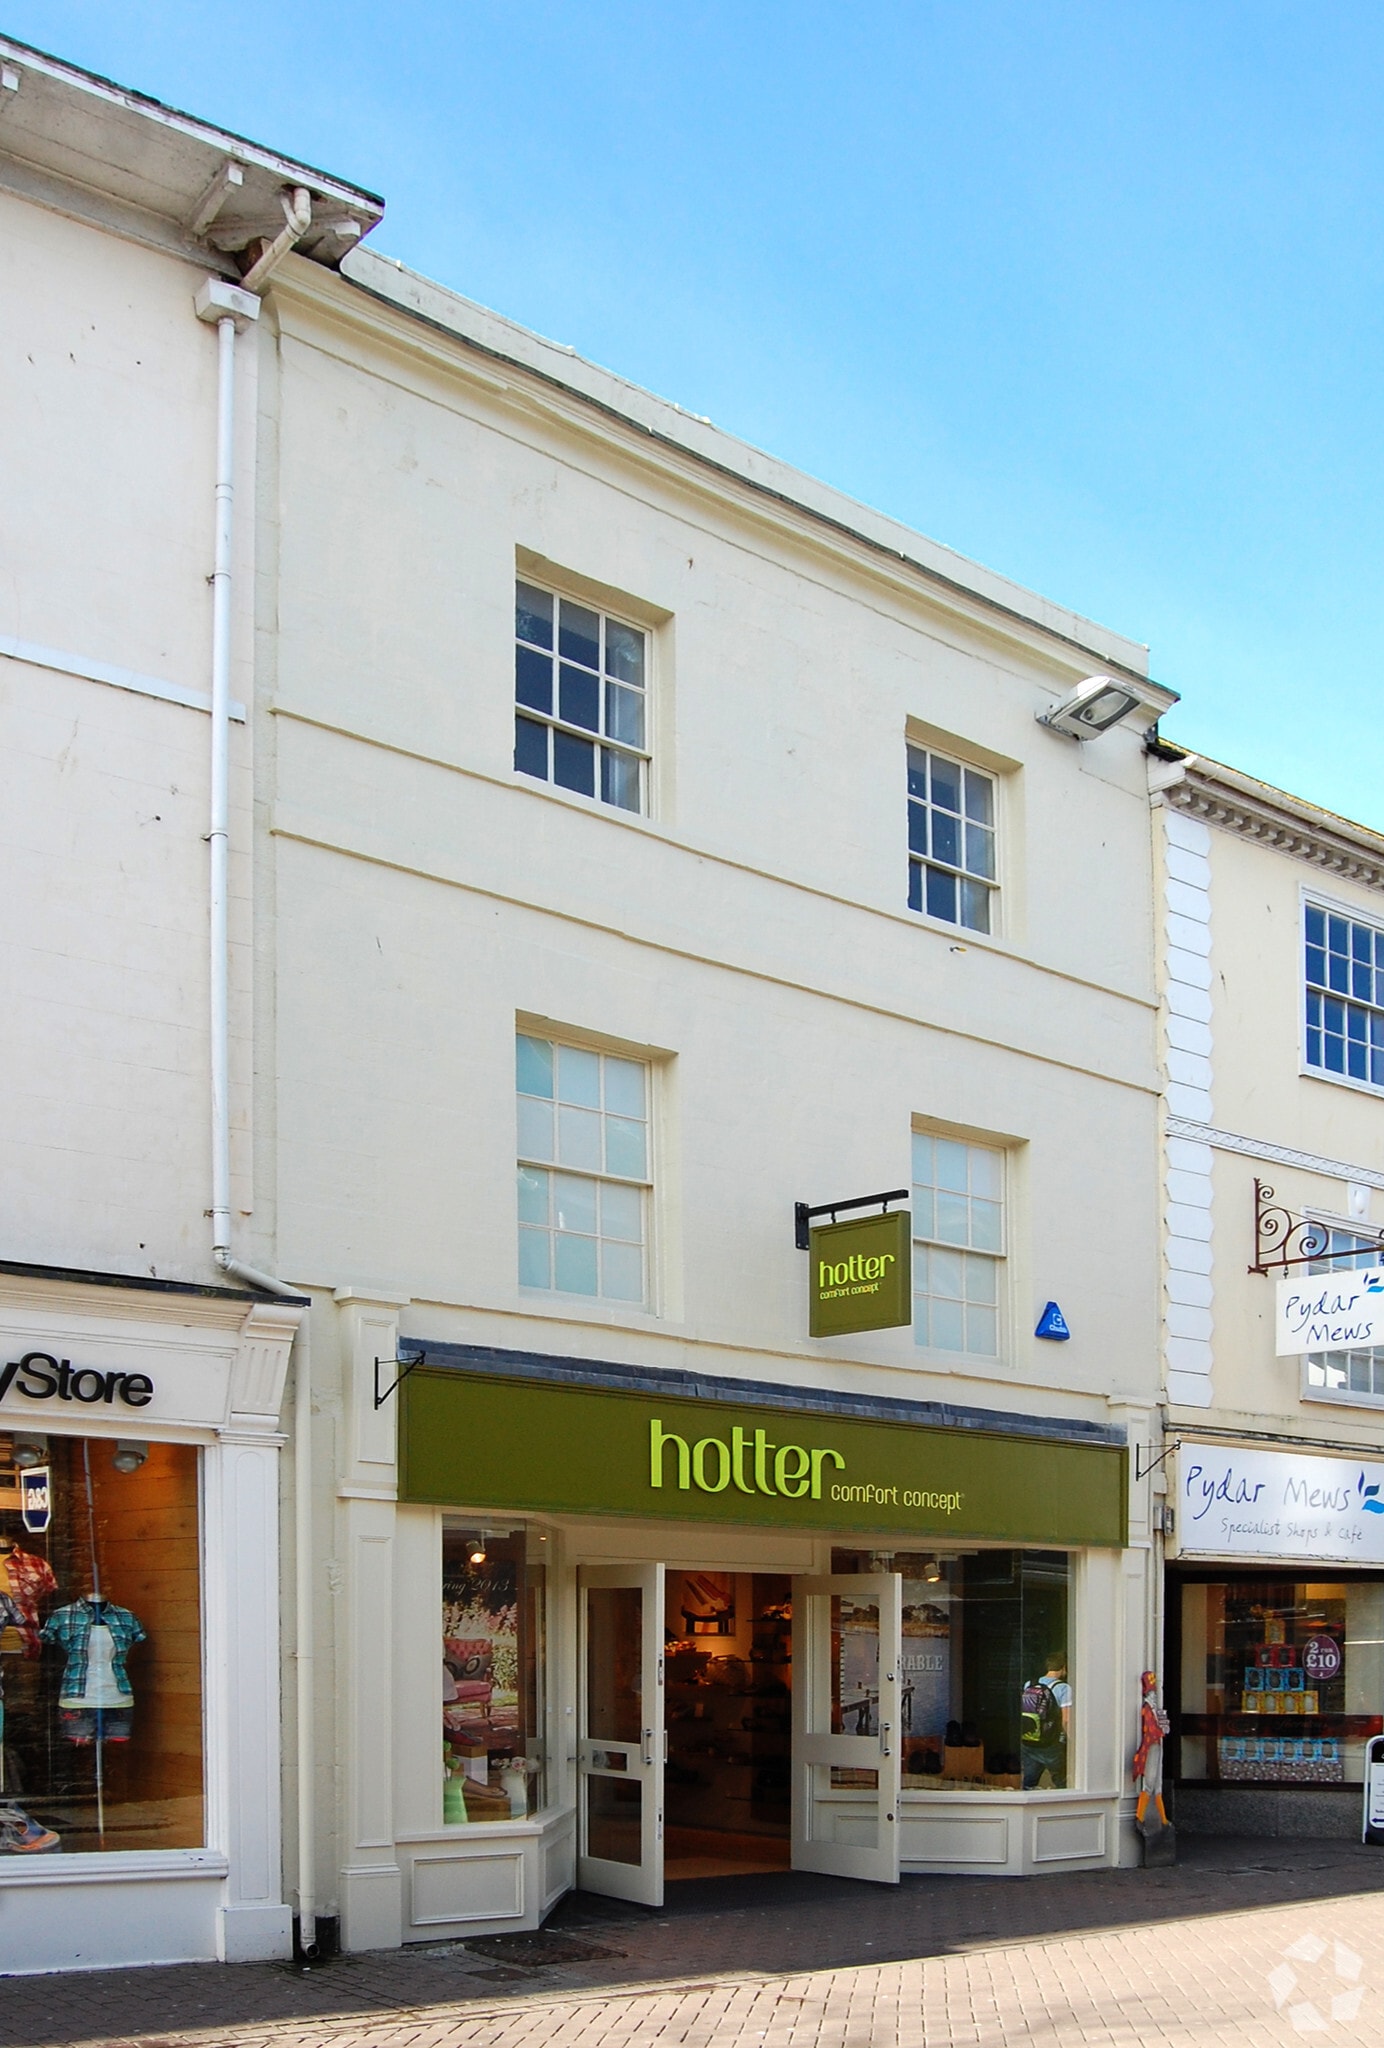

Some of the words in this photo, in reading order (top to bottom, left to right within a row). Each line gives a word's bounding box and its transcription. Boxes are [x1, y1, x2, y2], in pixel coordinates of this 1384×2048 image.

[819, 1254, 896, 1288] hotter
[819, 1287, 850, 1300] comfort
[850, 1282, 880, 1295] concept
[1285, 1290, 1361, 1333] Pydar
[1306, 1322, 1374, 1345] Mews
[650, 1419, 846, 1500] hotter
[830, 1484, 898, 1506] comfort
[903, 1490, 963, 1515] concept
[1186, 1466, 1266, 1520] Pydar
[1283, 1477, 1351, 1512] Mews
[1220, 1517, 1281, 1543] Specialist
[1286, 1522, 1318, 1547] Shops
[1306, 1654, 1337, 1668] £10
[1309, 1641, 1319, 1654] 2
